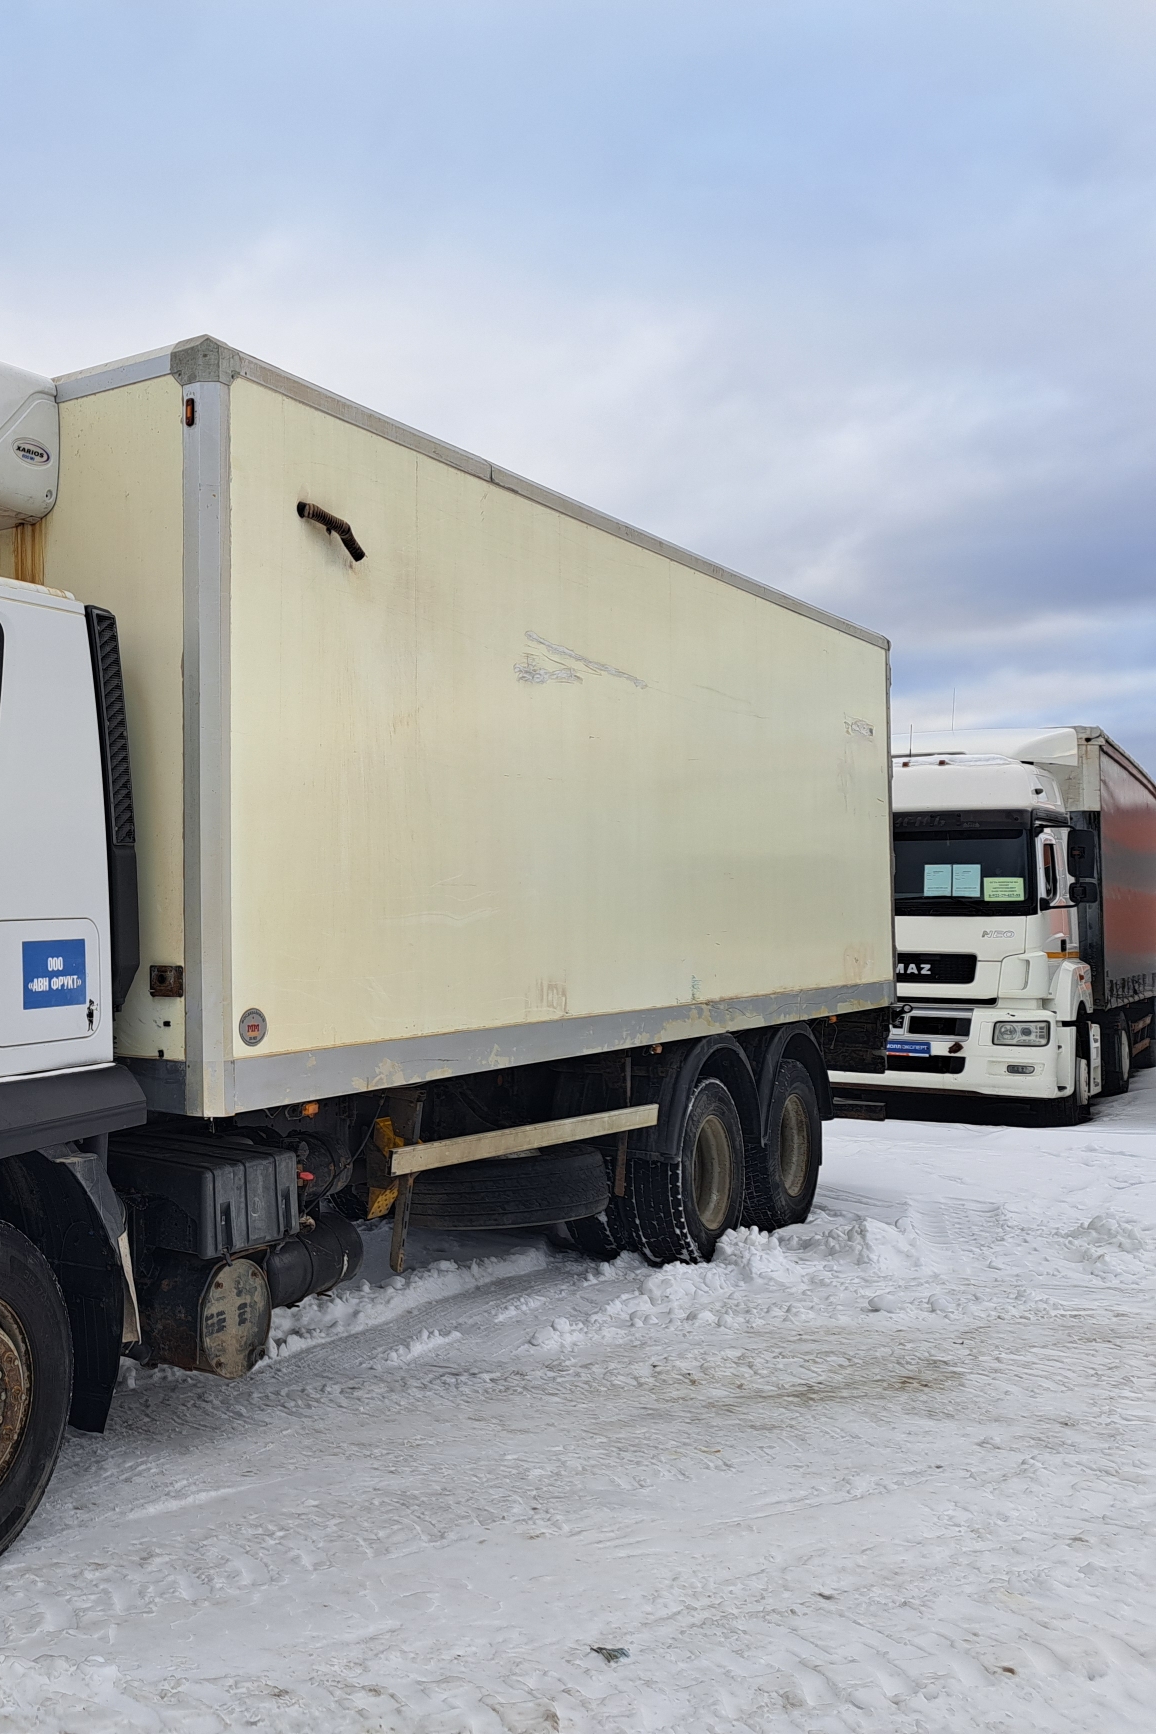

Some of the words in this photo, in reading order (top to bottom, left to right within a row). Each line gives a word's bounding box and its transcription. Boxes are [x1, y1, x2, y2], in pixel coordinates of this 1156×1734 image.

[16, 445, 45, 459] XARIOS
[981, 930, 1015, 938] NEO
[47, 956, 64, 971] ООО
[28, 977, 49, 992] «АВН
[51, 975, 82, 990] ФРУКТ»
